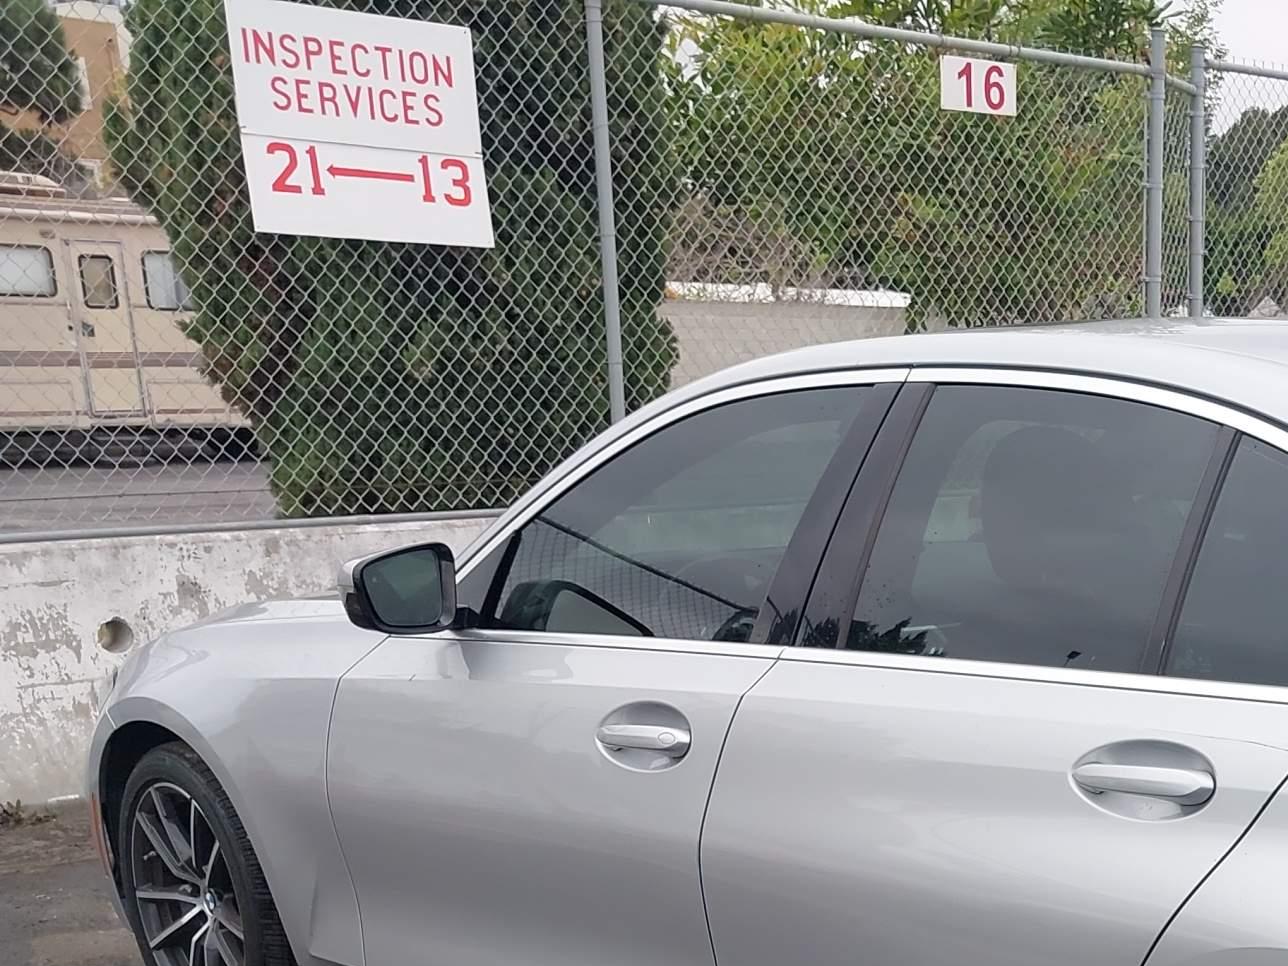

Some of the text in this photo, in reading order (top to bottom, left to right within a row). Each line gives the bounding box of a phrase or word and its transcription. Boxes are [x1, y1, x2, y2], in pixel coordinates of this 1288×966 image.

[241, 27, 454, 88] INSPECTION
[270, 76, 444, 127] SERVICES
[957, 62, 1005, 111] 16
[266, 142, 472, 207] 21 13
